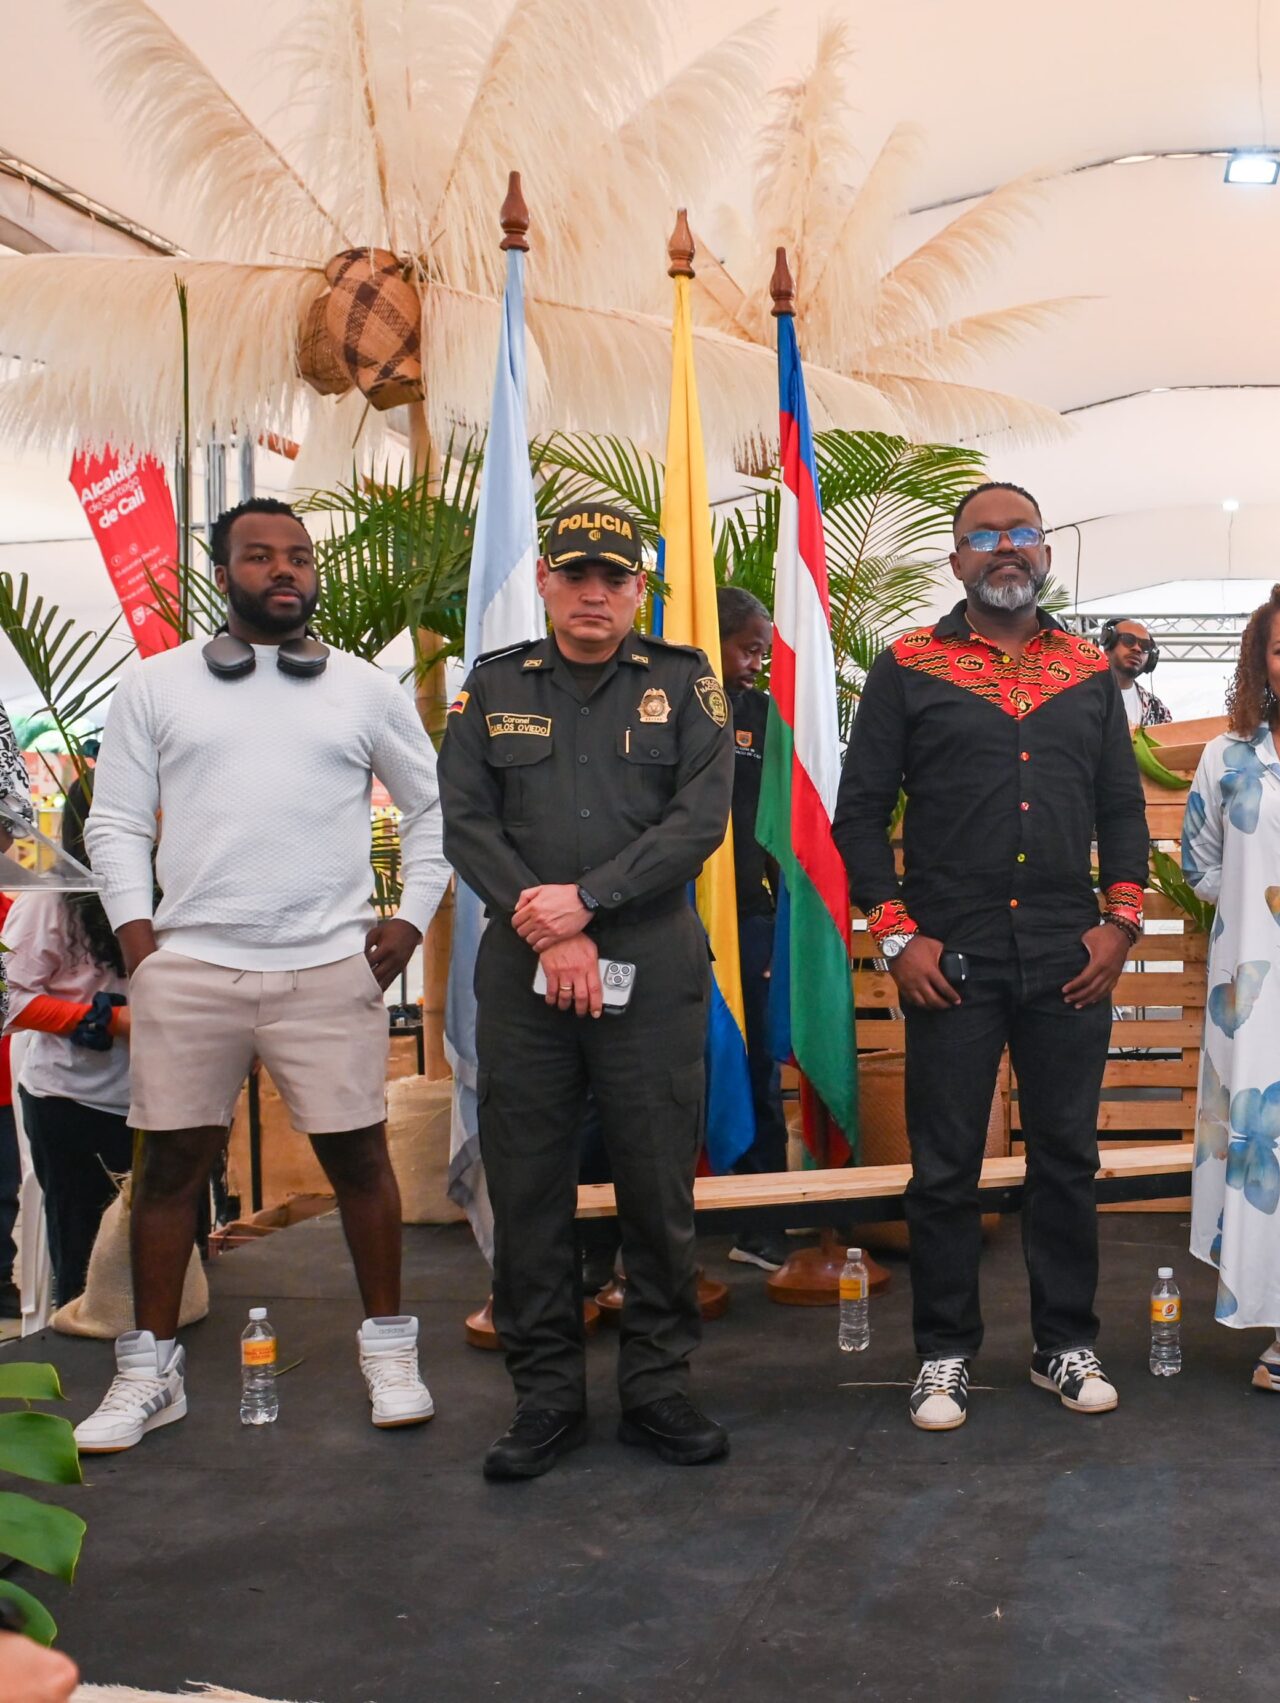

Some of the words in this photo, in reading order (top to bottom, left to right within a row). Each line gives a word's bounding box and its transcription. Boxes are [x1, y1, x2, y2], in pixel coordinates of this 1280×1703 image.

[88, 500, 104, 514] de
[101, 475, 140, 506] Santiago
[98, 508, 119, 529] de
[118, 485, 146, 515] Cali
[557, 512, 633, 541] POLICIA
[502, 715, 531, 724] Coronel
[517, 724, 547, 734] OVIEDO
